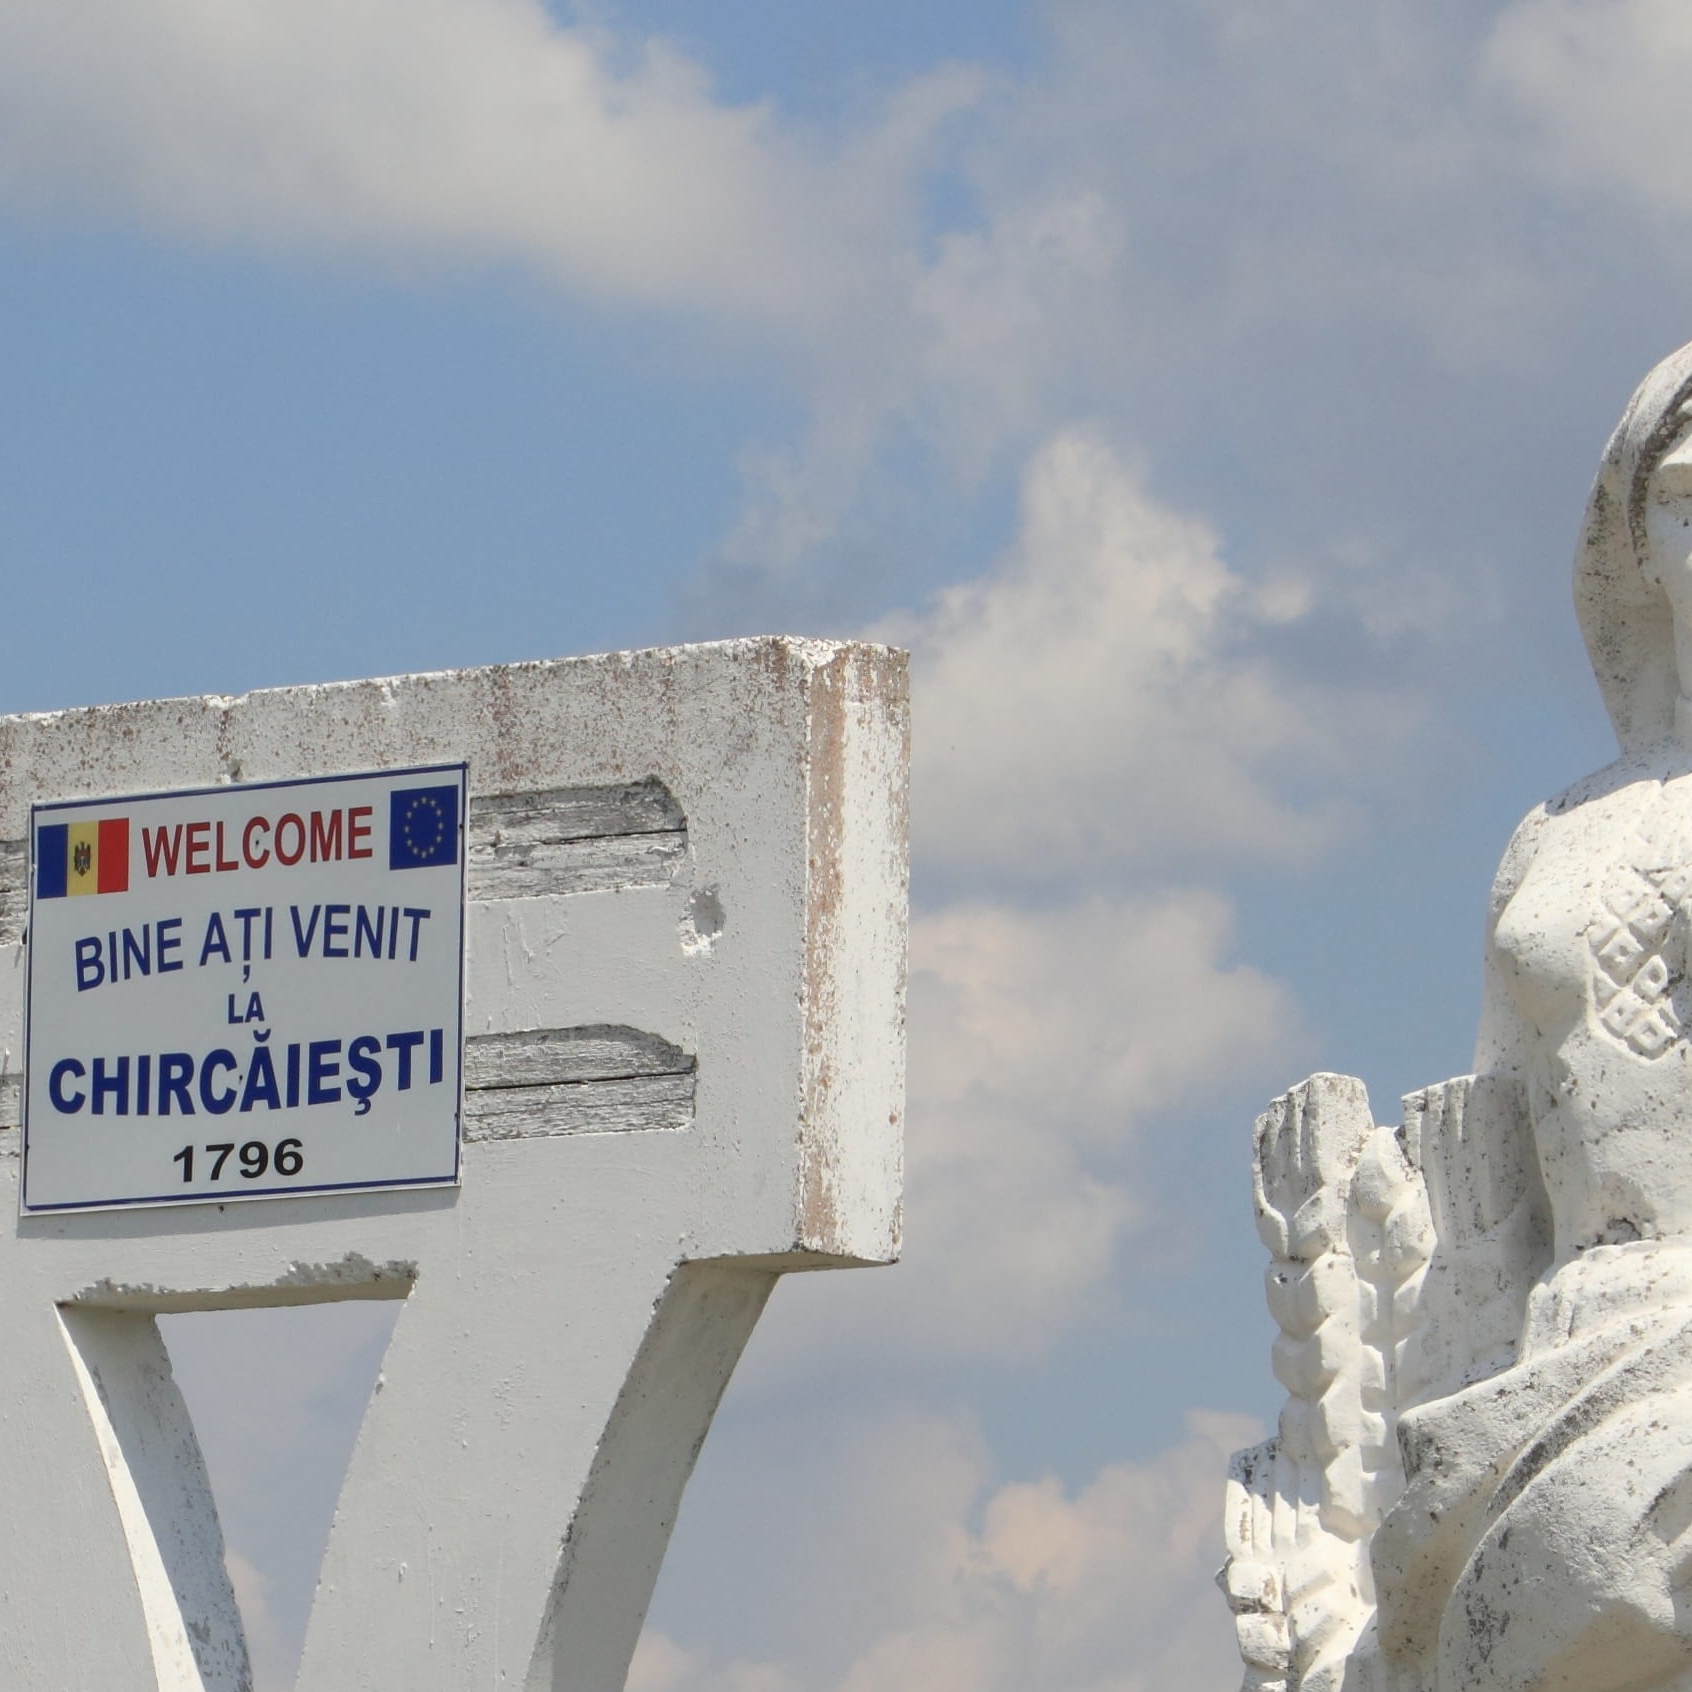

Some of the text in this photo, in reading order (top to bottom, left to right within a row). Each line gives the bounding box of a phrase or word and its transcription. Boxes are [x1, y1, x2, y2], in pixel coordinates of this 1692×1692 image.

[142, 806, 373, 877] WELCOME
[75, 917, 184, 992] BINE
[290, 905, 431, 962] VENIT
[228, 991, 265, 1024] LA
[173, 1138, 304, 1182] 1796
